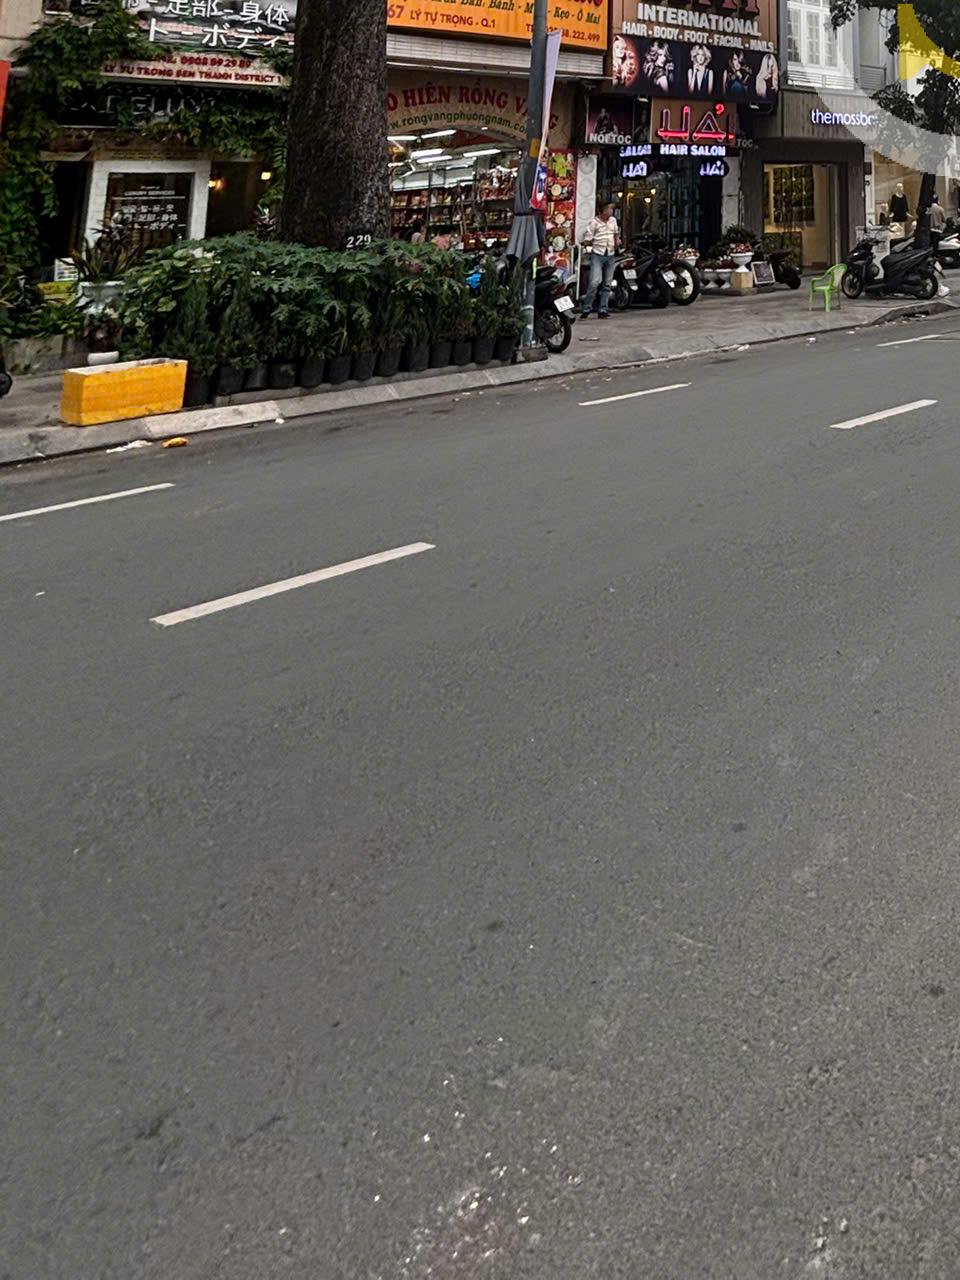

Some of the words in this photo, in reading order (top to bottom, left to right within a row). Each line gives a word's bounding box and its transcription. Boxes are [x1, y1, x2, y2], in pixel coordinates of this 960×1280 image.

[440, 14, 474, 27] TRỌNG
[637, 2, 762, 37] INTERNATIONAL
[622, 21, 648, 36] HAIR
[653, 26, 680, 40] BODY
[684, 30, 709, 44] FOOT
[714, 34, 744, 49] FACIAL
[750, 39, 774, 53] NAILS
[402, 81, 451, 108] HIÊN
[659, 143, 688, 156] HAIR
[690, 144, 726, 157] SALON
